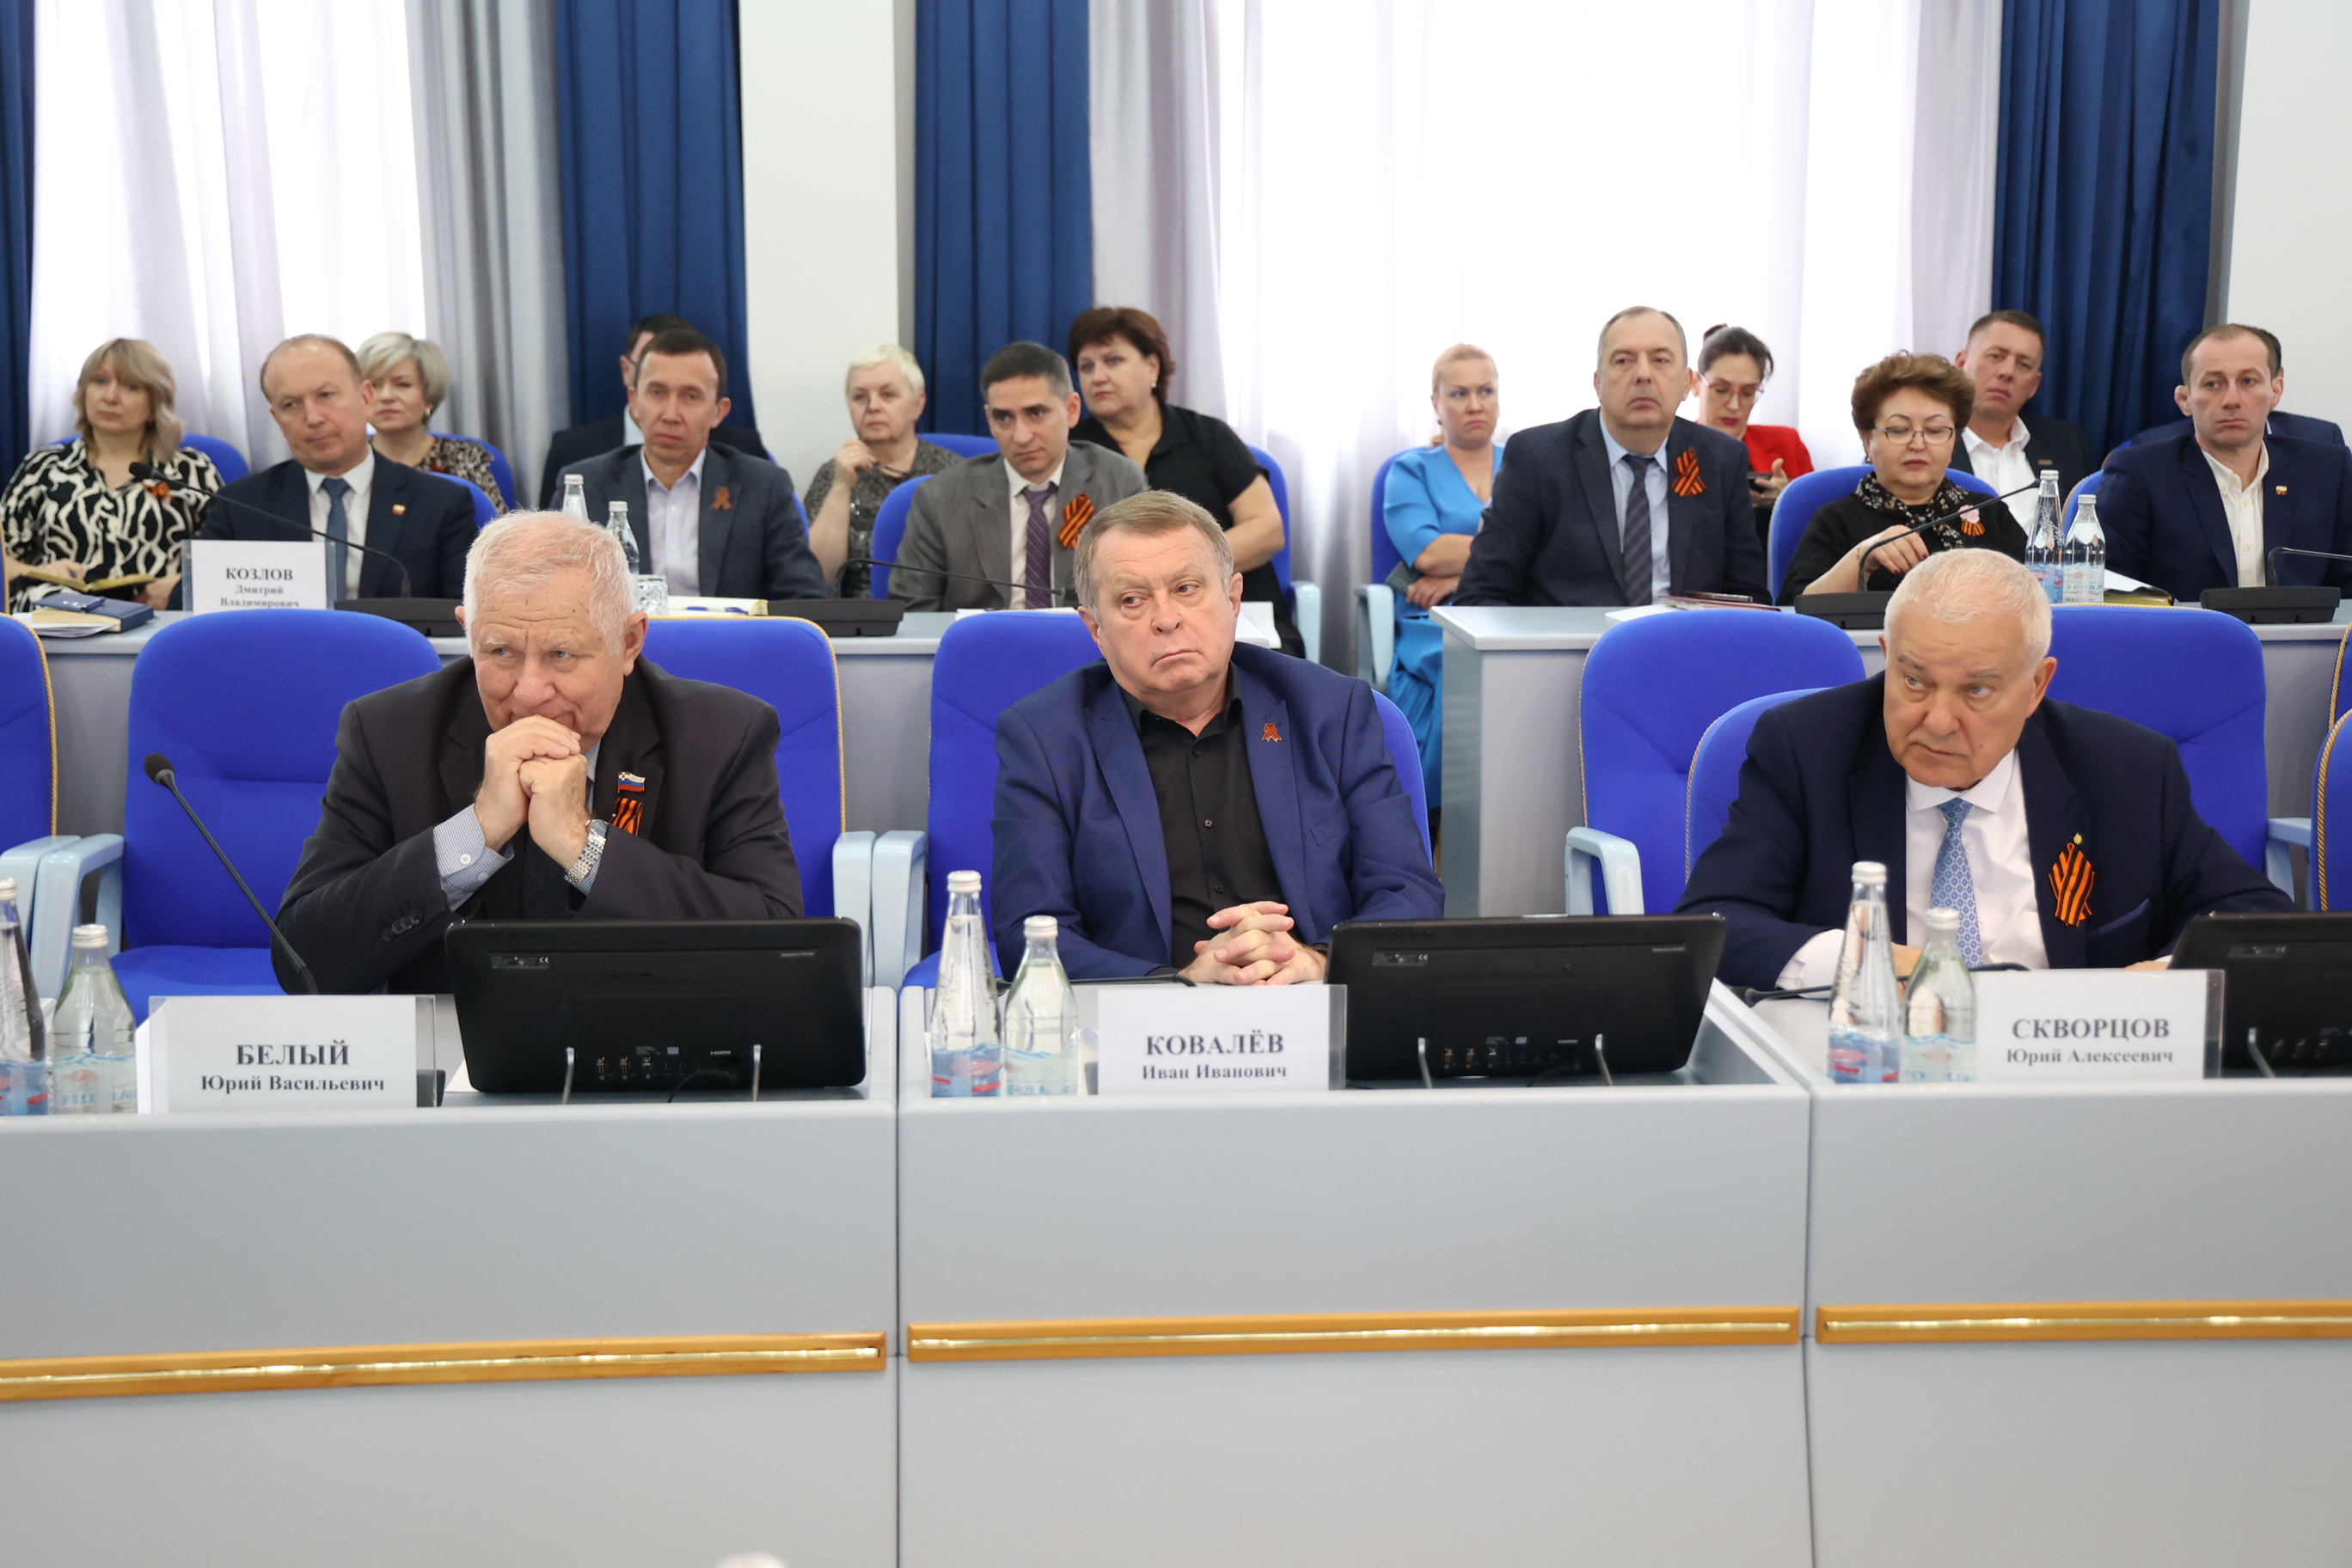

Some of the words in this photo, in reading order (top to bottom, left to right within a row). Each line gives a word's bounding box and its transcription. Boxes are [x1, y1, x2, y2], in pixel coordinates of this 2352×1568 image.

[226, 567, 294, 581] КОЗЛОВ
[235, 585, 284, 596] Дмитрий
[220, 597, 300, 609] Владимирович
[2012, 1018, 2171, 1042] СКВОРЦОВ
[1145, 1028, 1284, 1056] КОВАЛЁВ
[236, 1039, 350, 1065] БЕЛЫЙ
[2006, 1048, 2061, 1067] Юрий
[2067, 1049, 2173, 1063] Алексеевич
[1142, 1064, 1190, 1080] Иван
[1196, 1063, 1288, 1079] Иванович
[201, 1075, 262, 1094] Юрий
[269, 1075, 385, 1091] Васильевич
